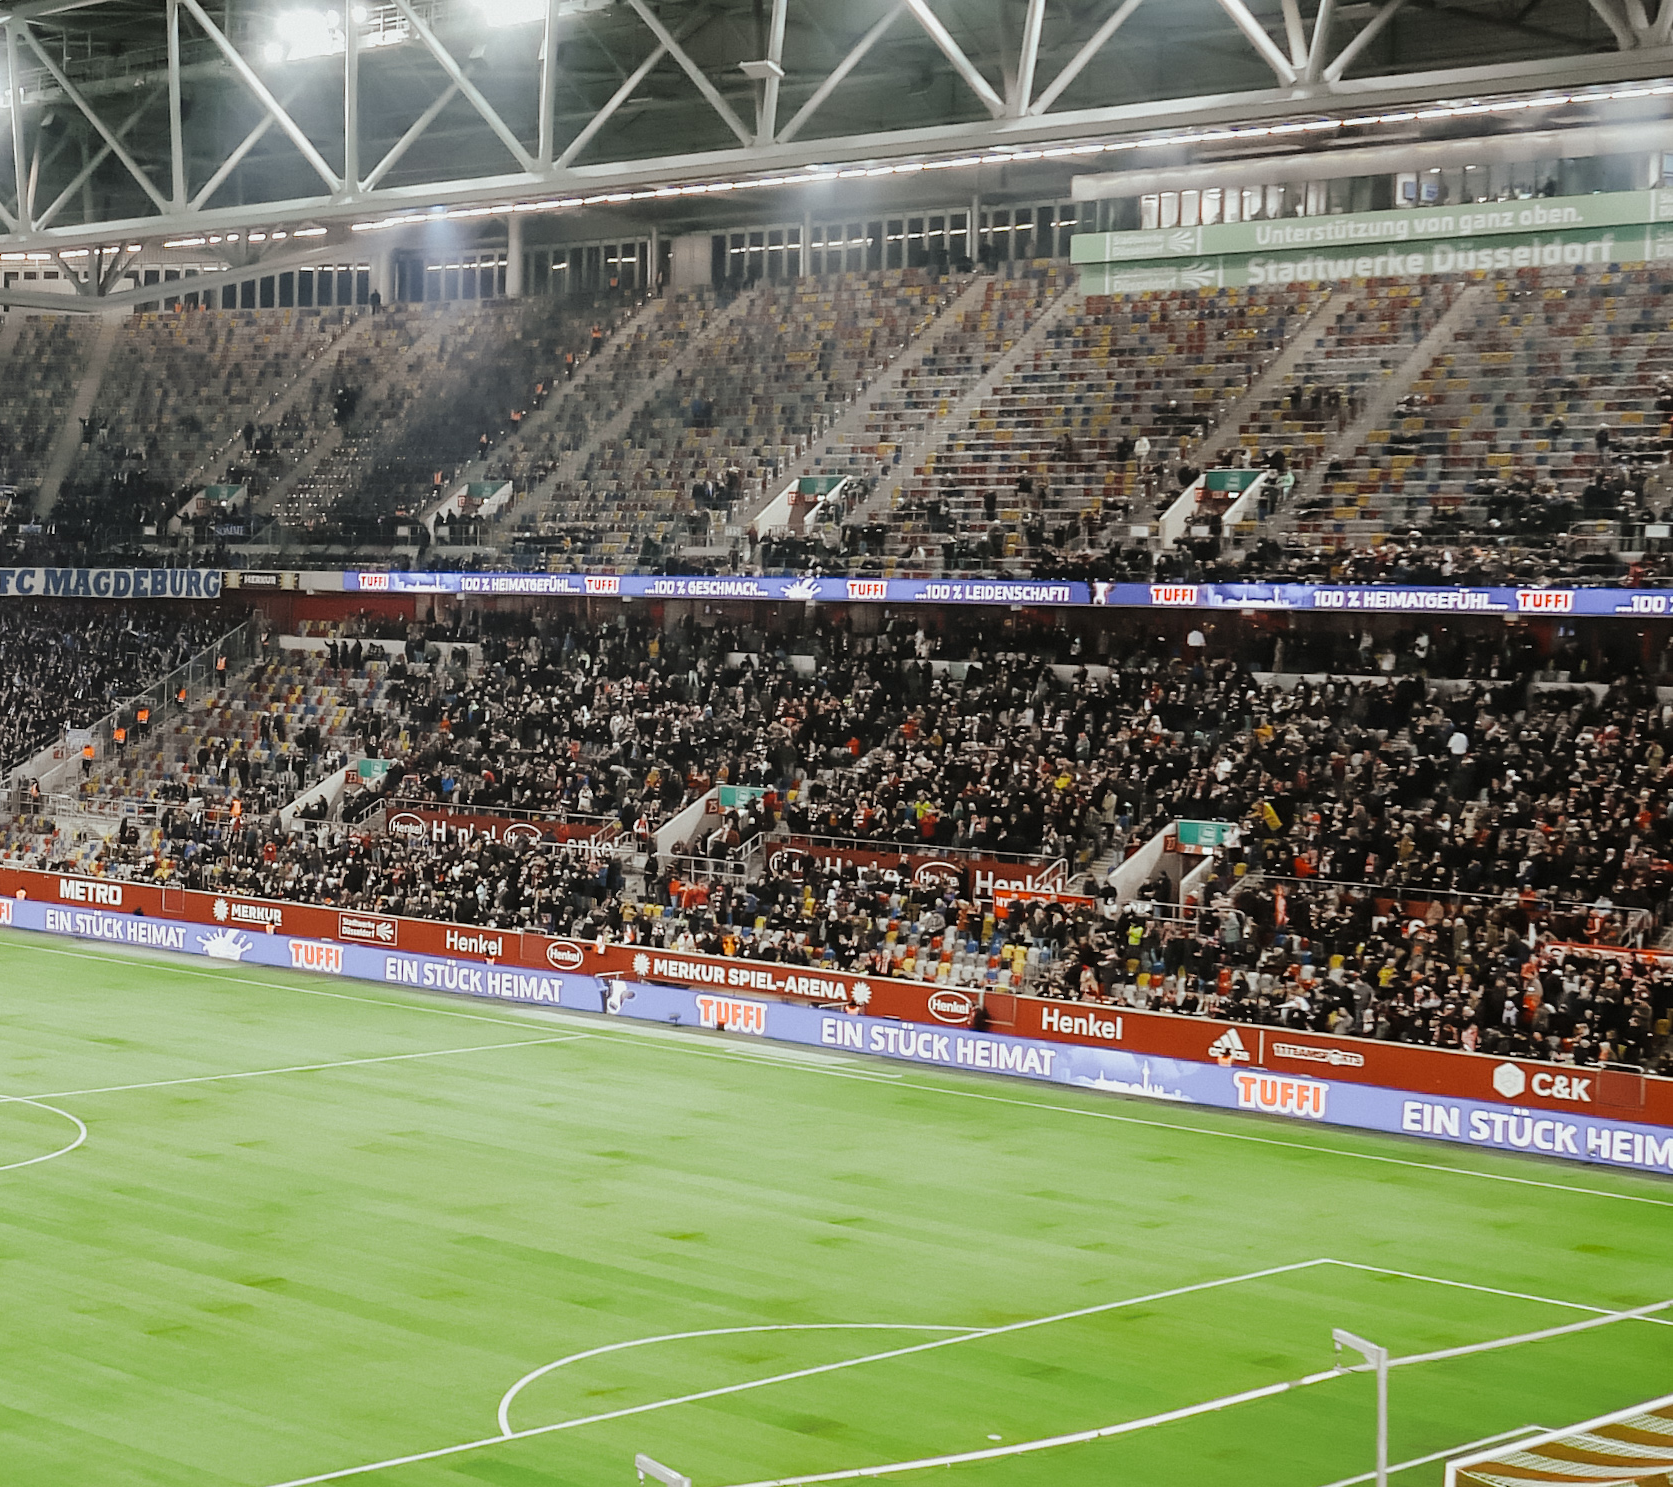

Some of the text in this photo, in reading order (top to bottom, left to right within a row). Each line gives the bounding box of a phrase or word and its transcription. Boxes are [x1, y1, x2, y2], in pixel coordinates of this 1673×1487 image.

[1255, 205, 1584, 247] Unterstützung von ganz oben.
[1248, 247, 1423, 286] Stadtwerke
[1432, 235, 1614, 273] Düsseldorf
[42, 569, 220, 597] MAGDEBURG
[358, 573, 389, 591] TUFFI
[460, 577, 478, 591] 100
[480, 578, 490, 591] %
[584, 575, 620, 594] TUFFI
[677, 582, 686, 595] %
[846, 580, 888, 599] TUFFI
[952, 585, 963, 600] %
[965, 584, 1069, 602] LEIDENSCHAFT!
[1149, 585, 1198, 605] TUFFI
[1313, 590, 1344, 608] 100
[1347, 591, 1360, 608] %
[1516, 590, 1575, 612] TUFFI
[59, 879, 122, 906] METRO
[231, 902, 283, 922] MERKUR
[45, 909, 186, 949] EIN STÜCK HEIMAT
[445, 929, 503, 957] Henkel
[288, 939, 344, 974] TUFFI
[549, 948, 580, 962] Henkel
[385, 957, 563, 1003] EIN STÜCK HEIMAT
[653, 958, 848, 1001] MERKUR SPIEL-ARENA
[695, 994, 768, 1035] TUFFI
[931, 998, 970, 1014] Henkel
[1041, 1007, 1123, 1040] Henkel
[822, 1017, 1056, 1076] EIN STÜCK HEIMAT
[1233, 1070, 1328, 1119] TUFFI
[1530, 1072, 1592, 1102] C&K
[1402, 1101, 1460, 1137] EIN
[1469, 1107, 1579, 1155] STÜCK
